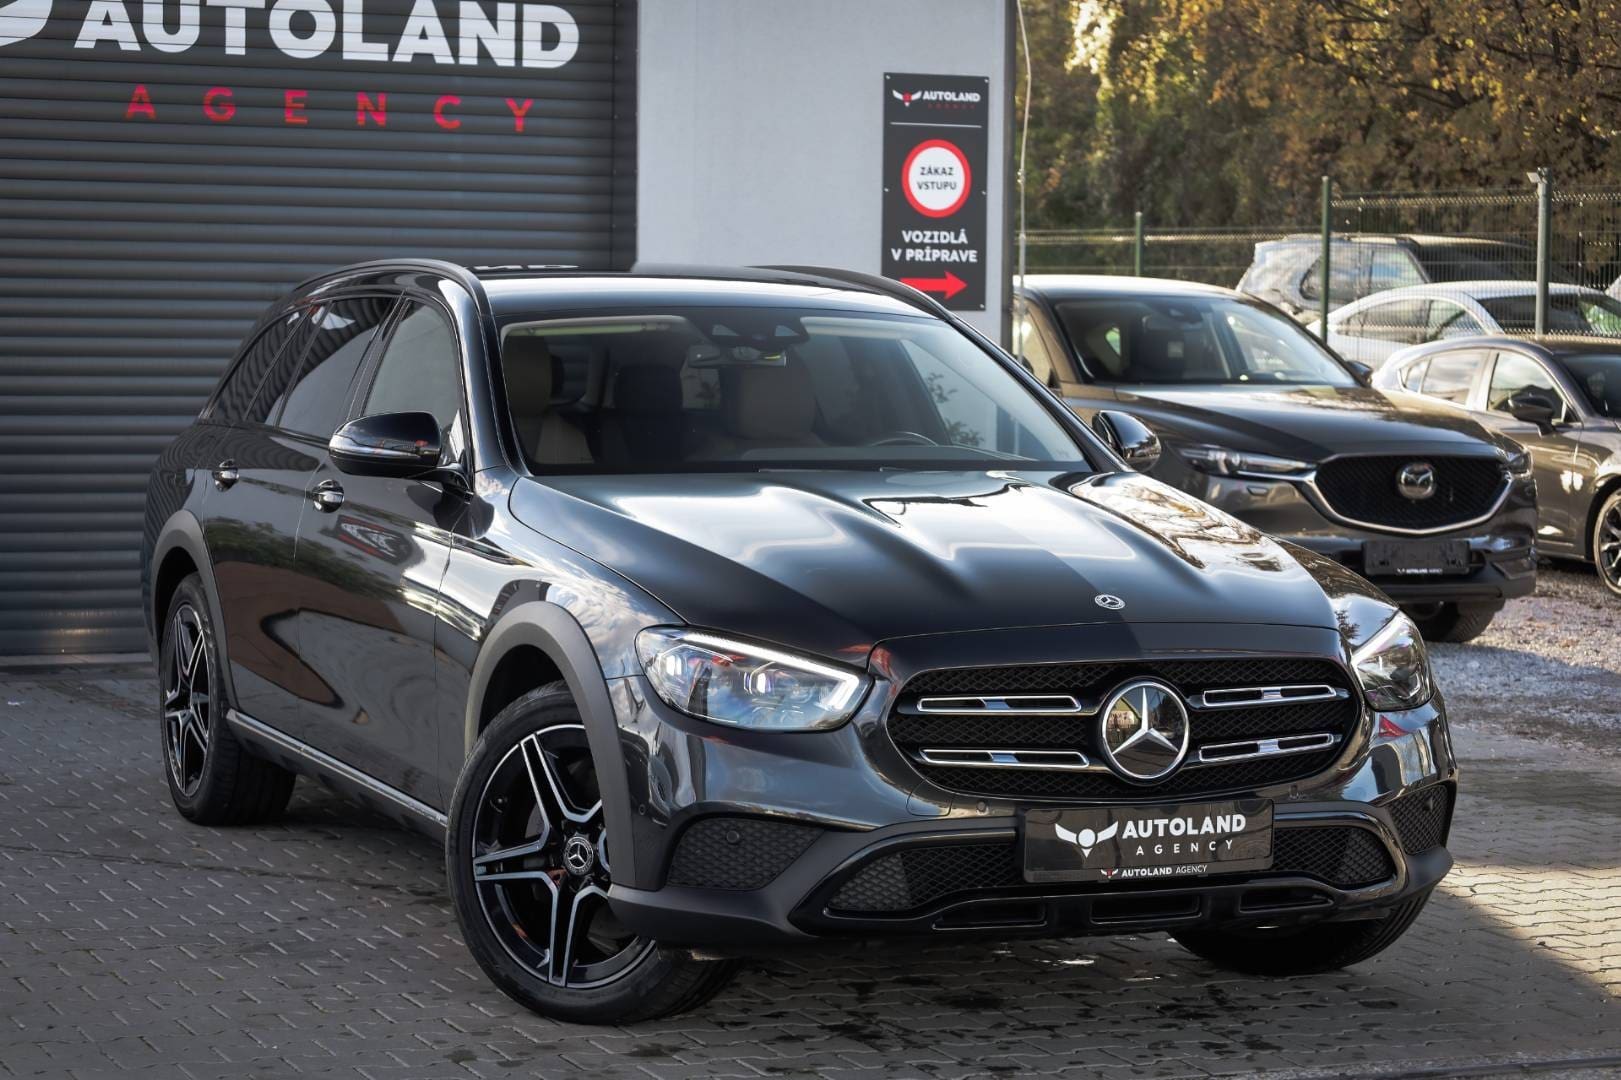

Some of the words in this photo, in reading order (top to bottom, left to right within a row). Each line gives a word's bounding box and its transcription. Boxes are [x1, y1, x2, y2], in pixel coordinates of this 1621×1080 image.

[73, 0, 580, 69] AUTOLAND
[922, 90, 982, 103] AUTOLAND
[124, 84, 534, 132] AGENCY
[920, 165, 954, 176] ZÁKAZ
[916, 181, 957, 190] VSTUPU
[901, 228, 968, 244] VOZIDLÁ
[891, 248, 902, 261] V
[905, 246, 978, 263] PRÍPRAVE
[1121, 814, 1247, 839] AUTOLAND
[1136, 839, 1233, 856] AGENCY
[1121, 867, 1173, 878] AUTOLAND
[1175, 864, 1208, 874] AGENCY
